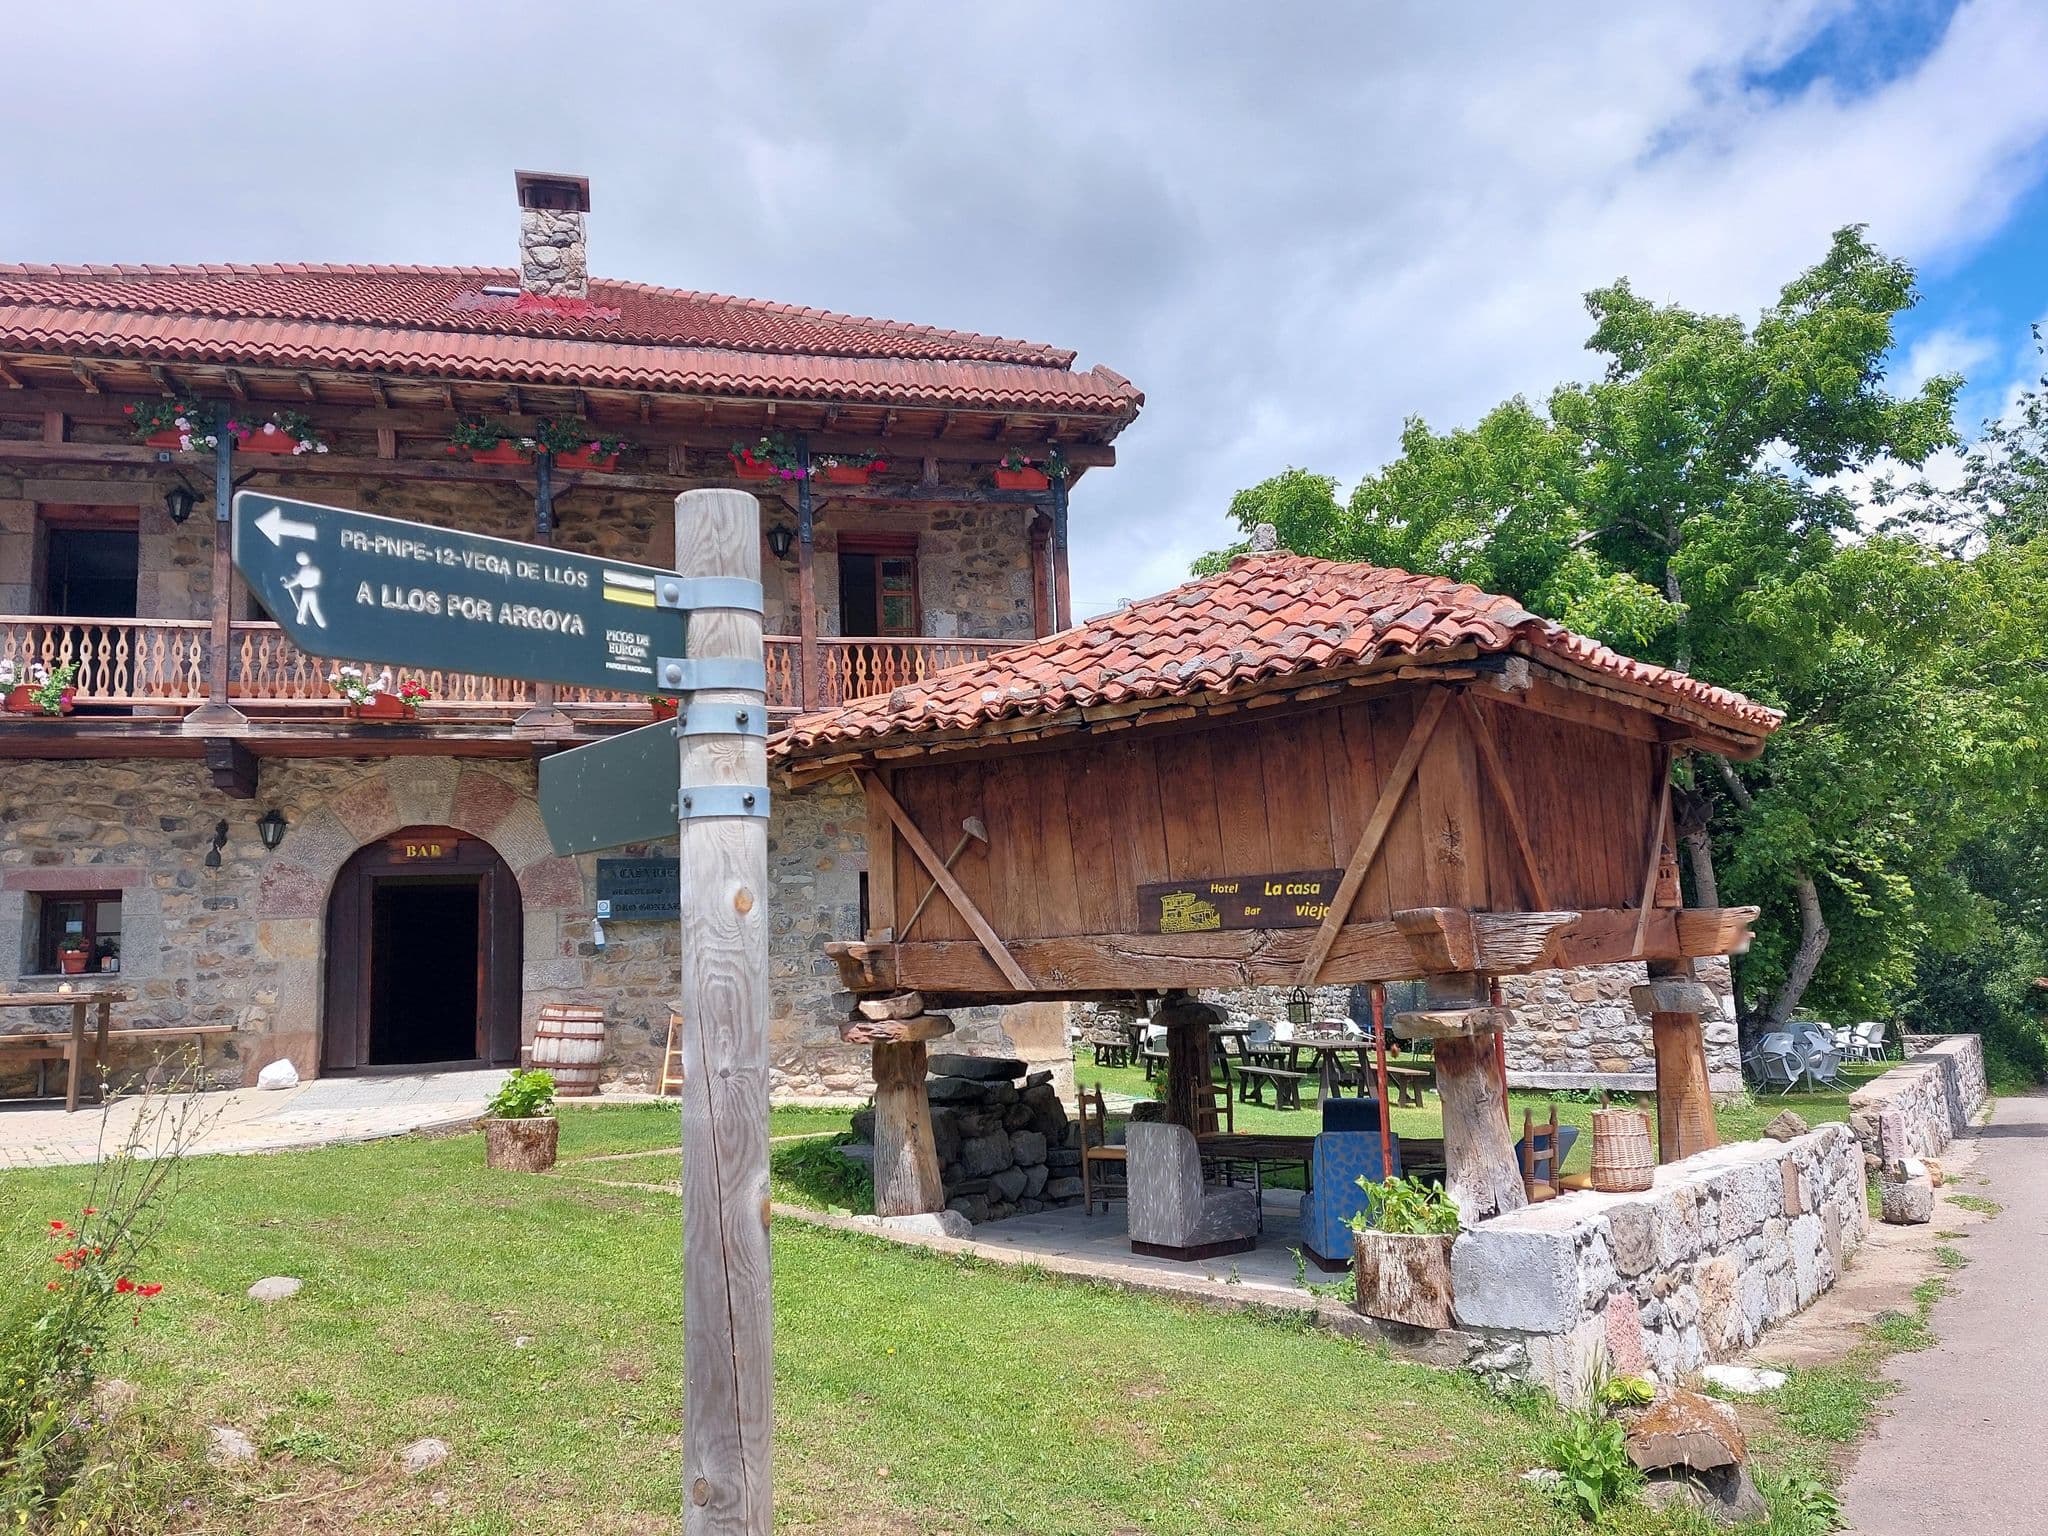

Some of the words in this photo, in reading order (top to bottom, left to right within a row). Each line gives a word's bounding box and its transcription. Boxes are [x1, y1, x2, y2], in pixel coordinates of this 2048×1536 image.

[340, 529, 511, 577] PR-PNPE-12-VEGA
[516, 560, 540, 580] DE
[356, 581, 374, 605] A
[381, 584, 441, 614] LLOS
[447, 594, 493, 623] POR
[499, 603, 585, 636] ARGOYA
[606, 630, 635, 643] PICOS
[636, 634, 649, 646] DE
[608, 642, 648, 658] EUROPA
[406, 845, 441, 857] BAR
[1210, 883, 1239, 893] Hotel
[1264, 881, 1282, 896] La
[1285, 882, 1320, 895] casa
[1244, 906, 1261, 916] Bar
